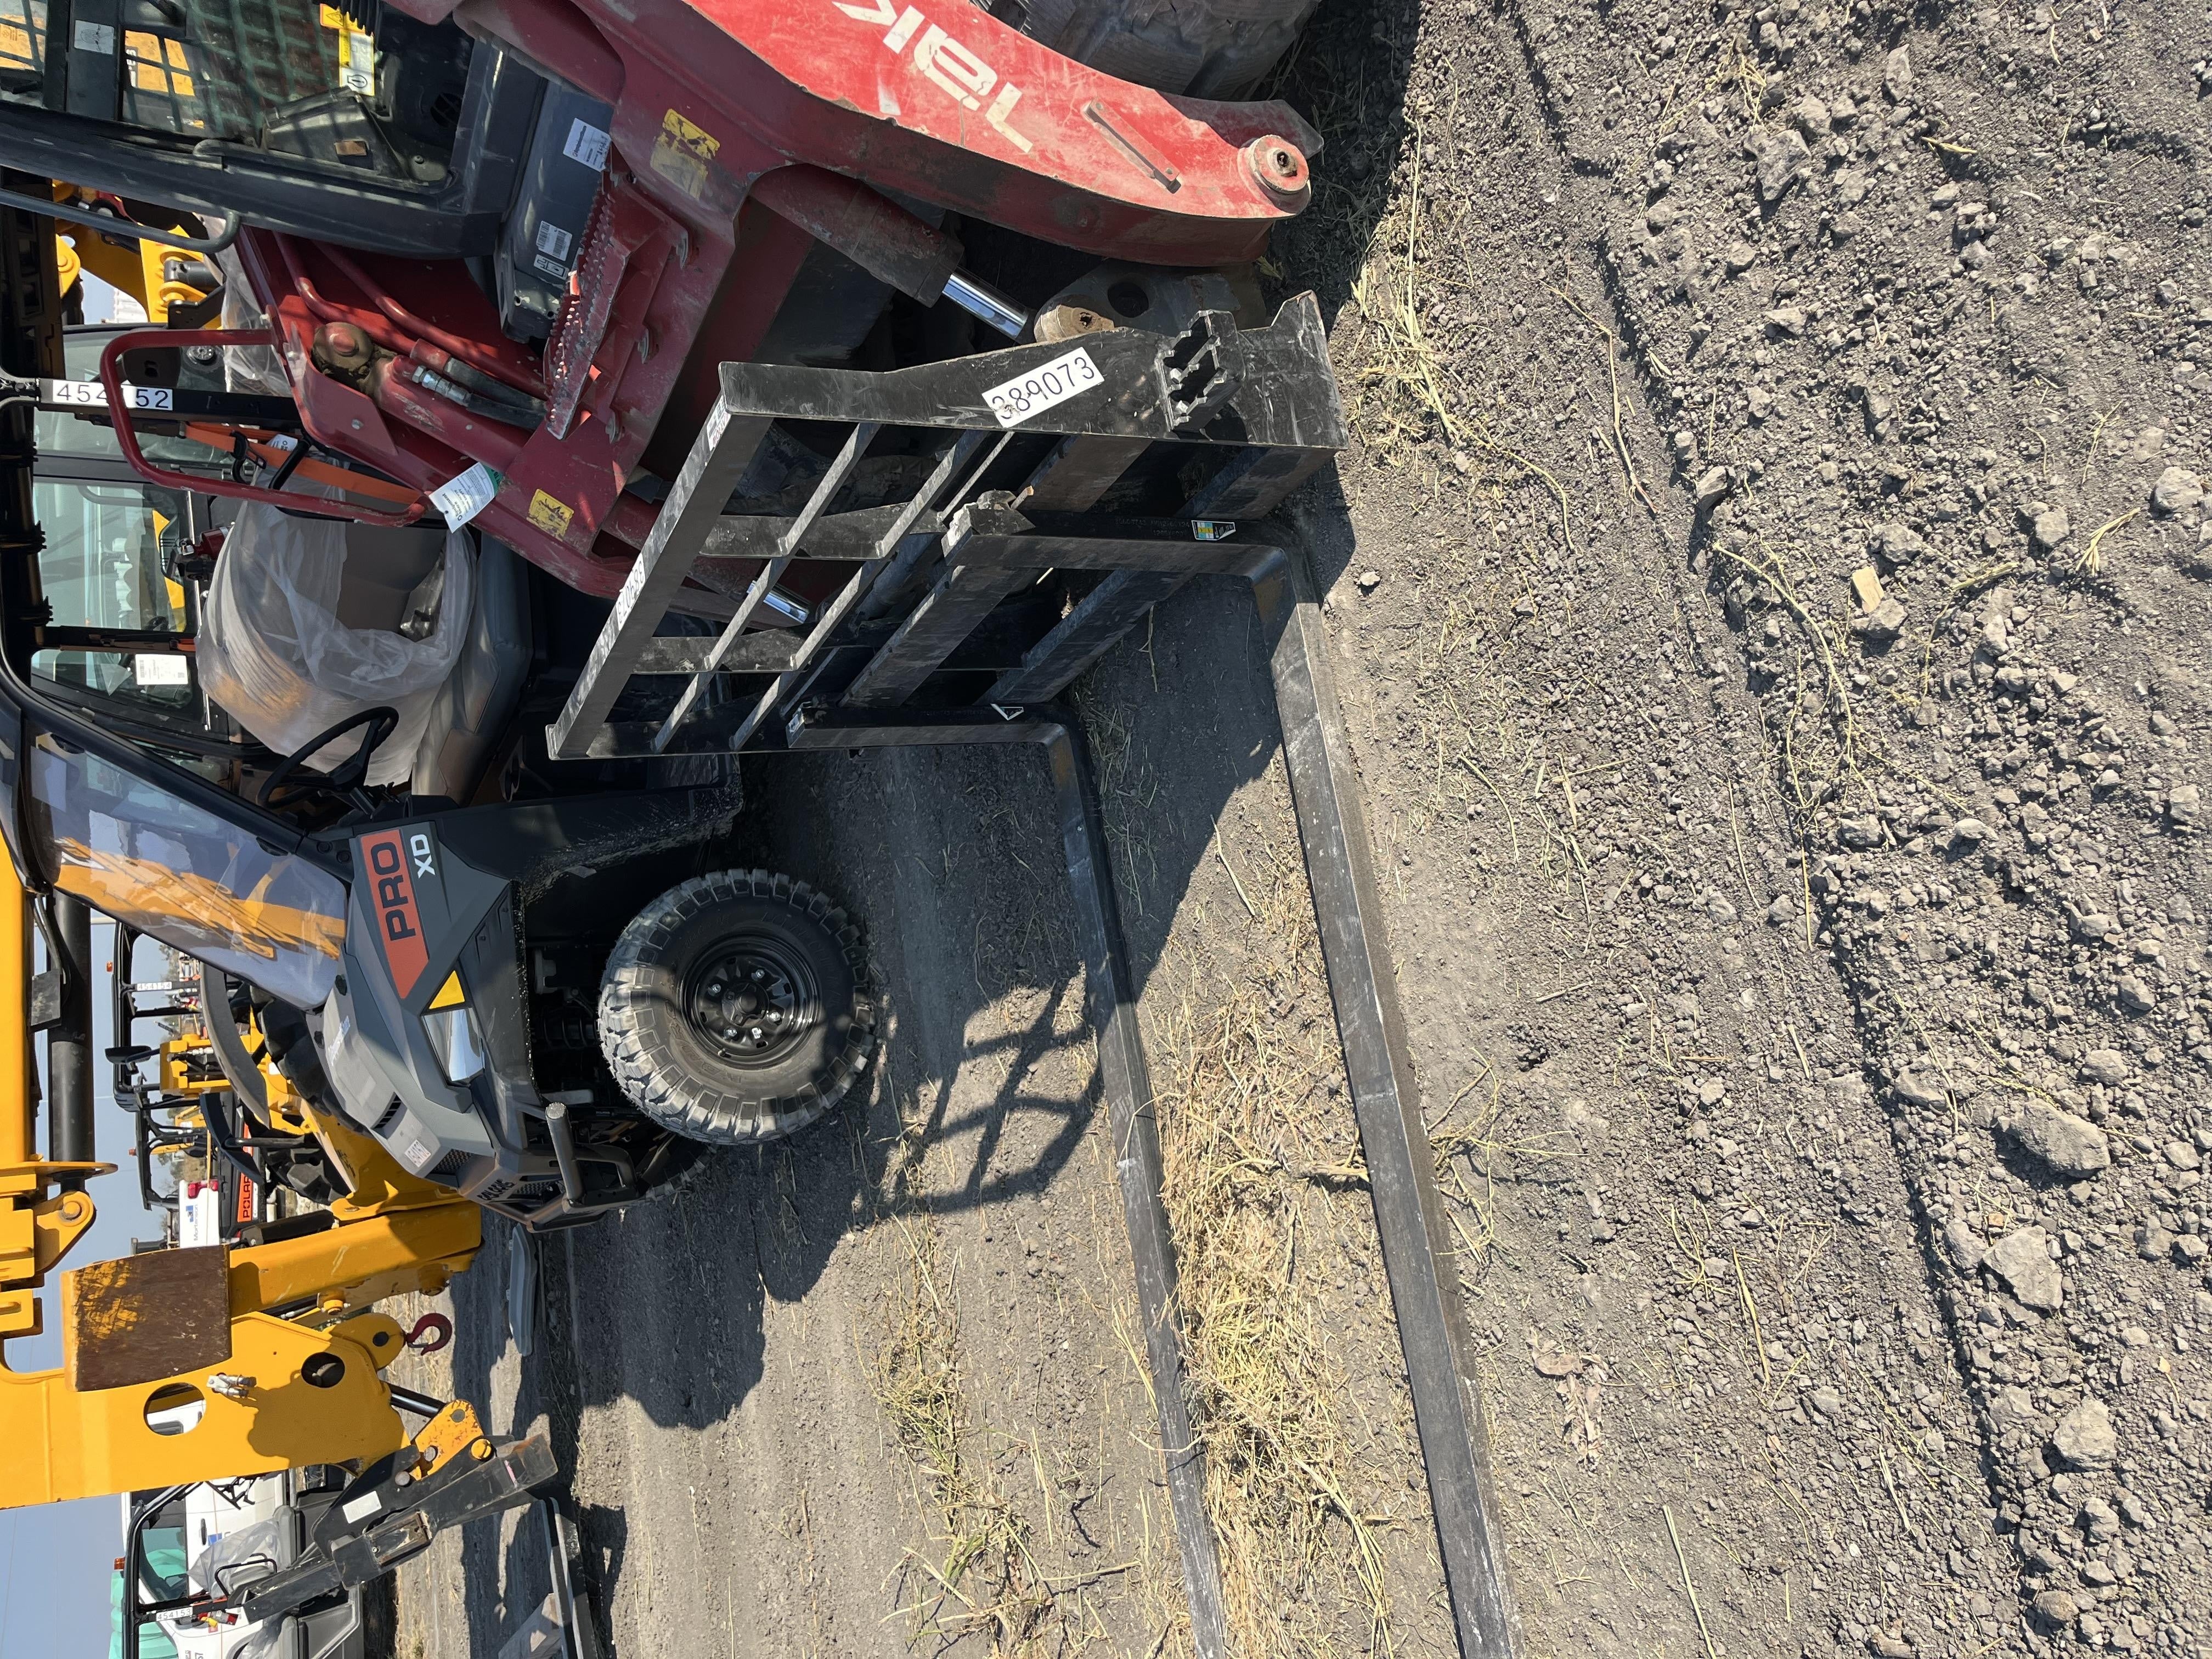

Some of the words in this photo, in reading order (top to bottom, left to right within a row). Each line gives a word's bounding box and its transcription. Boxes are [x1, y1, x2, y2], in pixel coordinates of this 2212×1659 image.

[57, 384, 168, 408] 45452
[992, 357, 1094, 419] 389073
[410, 834, 435, 878] XD
[371, 842, 416, 941] PRO
[157, 1609, 191, 1620] 454153
